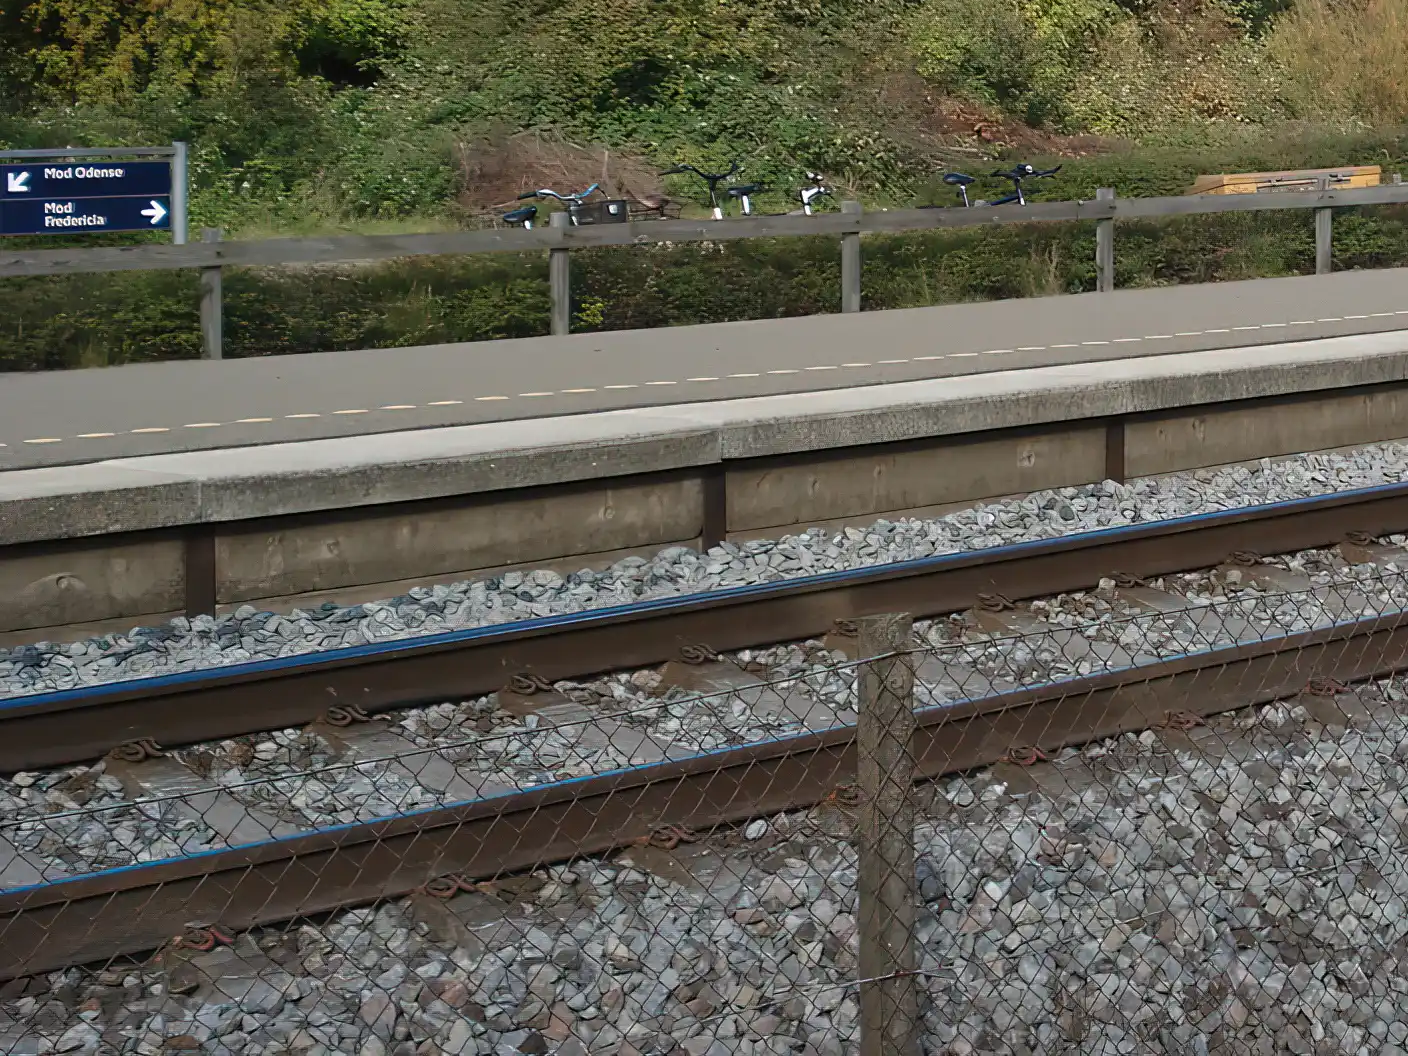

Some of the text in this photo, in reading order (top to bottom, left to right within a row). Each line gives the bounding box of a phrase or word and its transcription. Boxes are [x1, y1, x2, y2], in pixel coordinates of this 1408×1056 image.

[44, 166, 125, 179] Mod Odense
[44, 202, 74, 214] Mod
[44, 214, 107, 227] Fredericia
